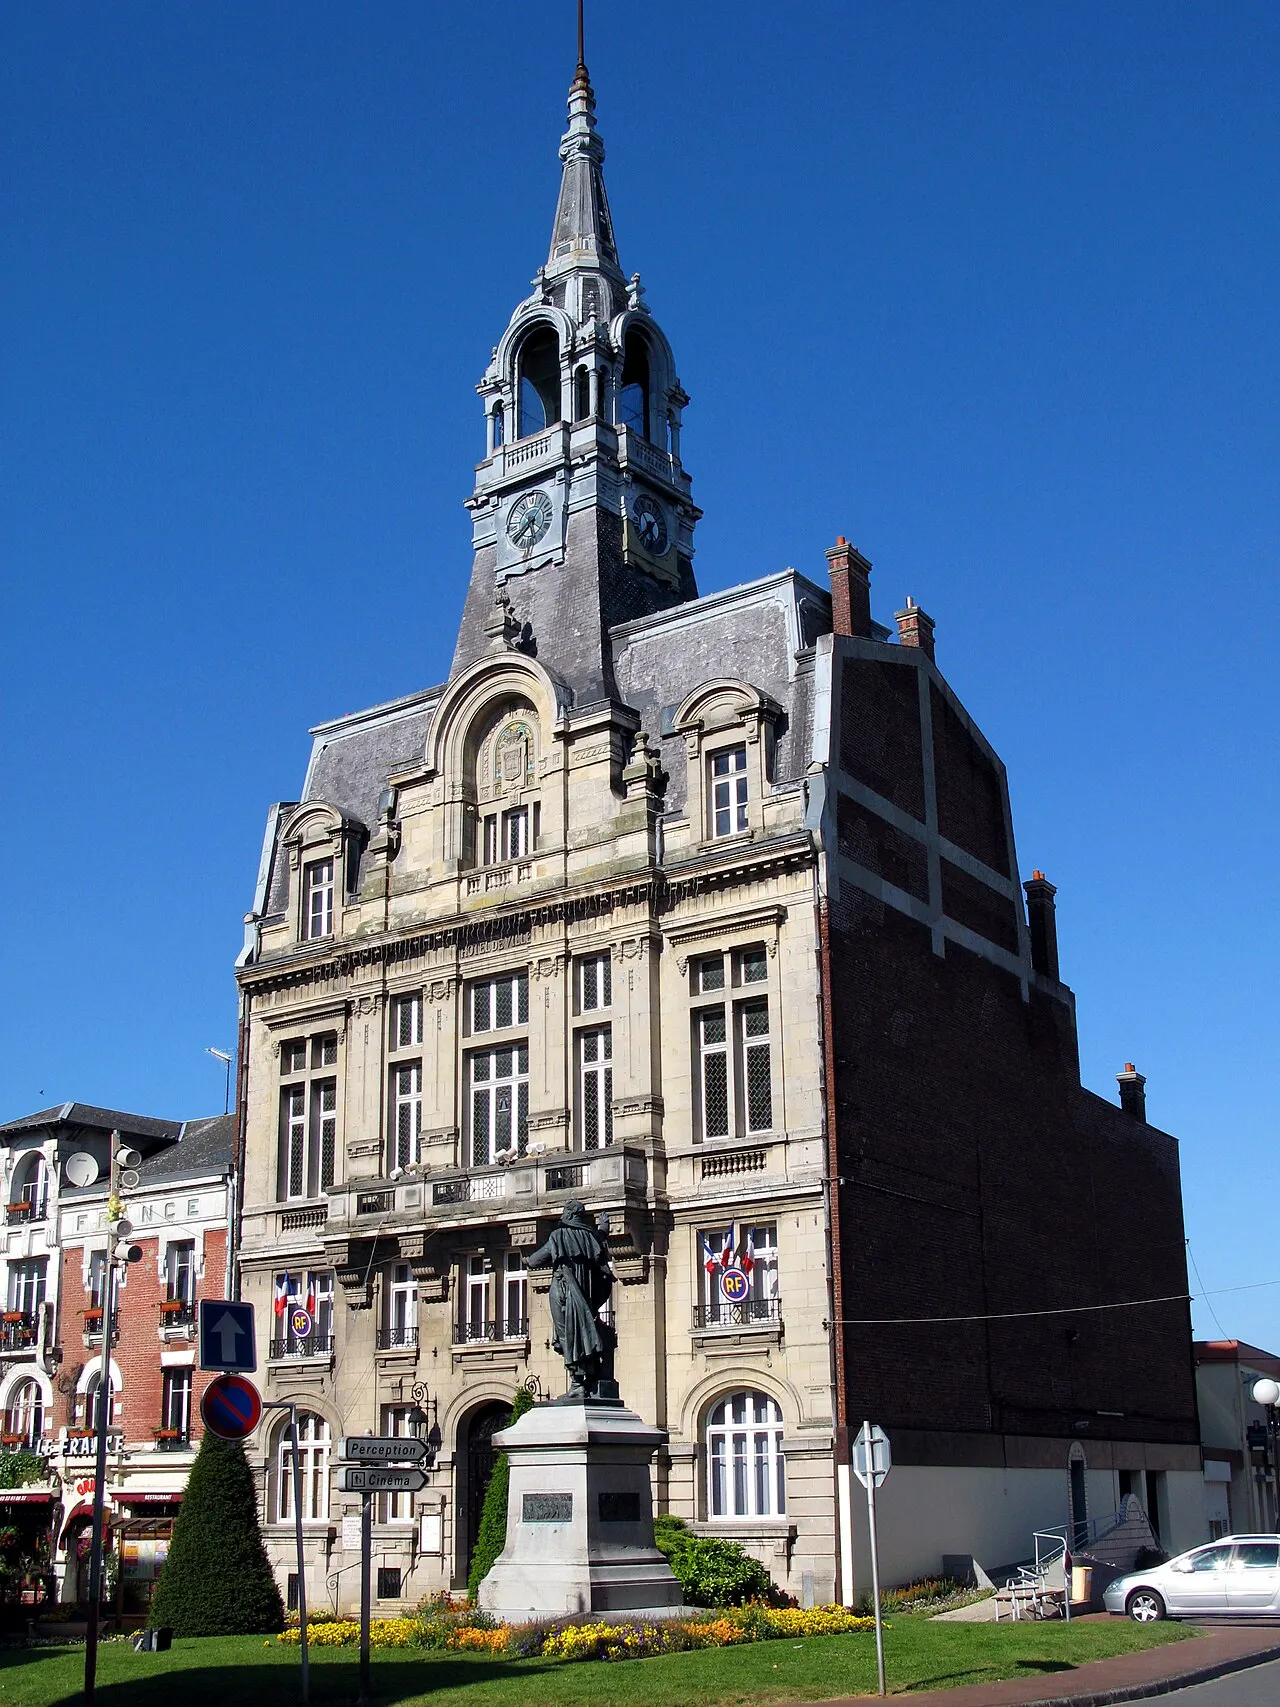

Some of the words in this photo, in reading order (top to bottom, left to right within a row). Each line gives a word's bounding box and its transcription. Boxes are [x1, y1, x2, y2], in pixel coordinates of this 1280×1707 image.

[491, 938, 504, 952] DE
[504, 931, 532, 950] VILLE
[725, 1277, 742, 1292] RF
[295, 1316, 306, 1329] RF
[35, 1437, 56, 1456] LE
[59, 1434, 125, 1455] FRANCE
[351, 1443, 416, 1457] Perception
[369, 1474, 410, 1486] Cinéma
